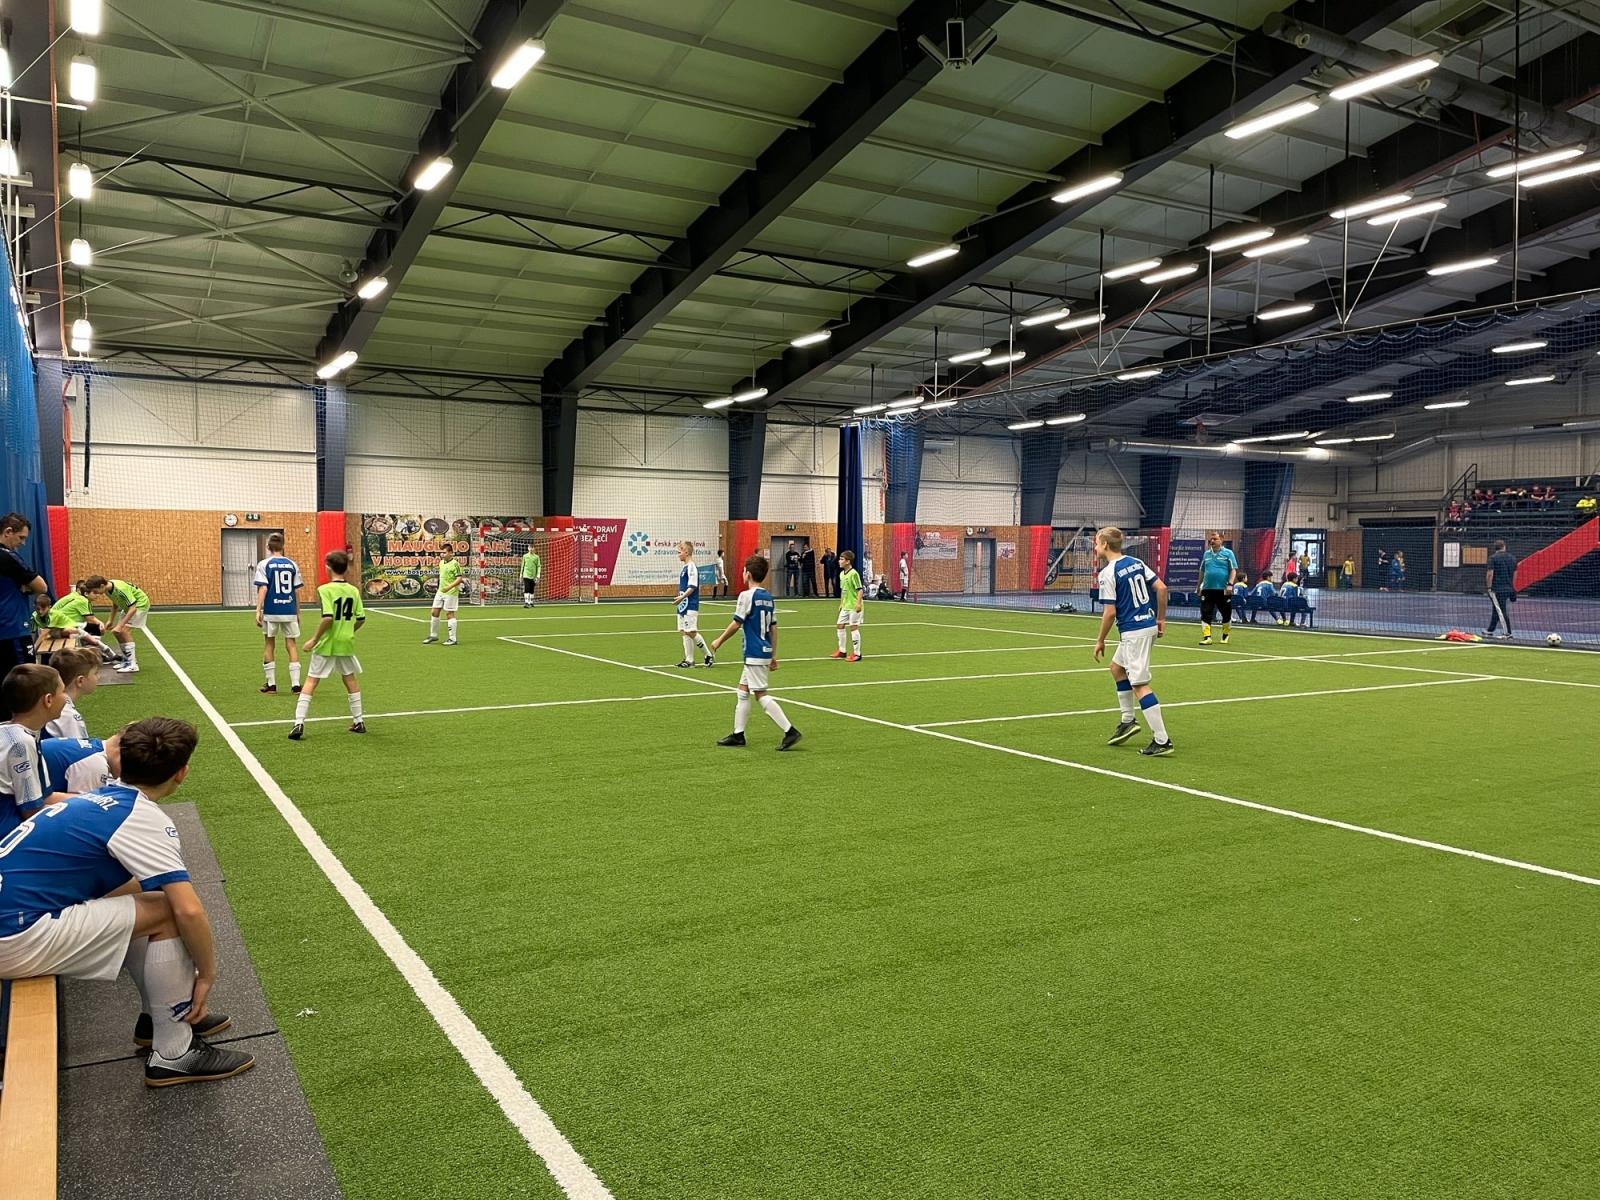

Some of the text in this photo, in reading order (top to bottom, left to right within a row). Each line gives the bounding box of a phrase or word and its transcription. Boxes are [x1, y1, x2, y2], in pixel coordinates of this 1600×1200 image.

[387, 540, 470, 553] MAUGLHO
[580, 534, 608, 542] BEZEČÍ
[371, 555, 382, 567] V
[383, 555, 467, 567] HOBBYPAU
[274, 570, 292, 594] 19
[1128, 573, 1150, 608] 10
[333, 597, 354, 621] 14
